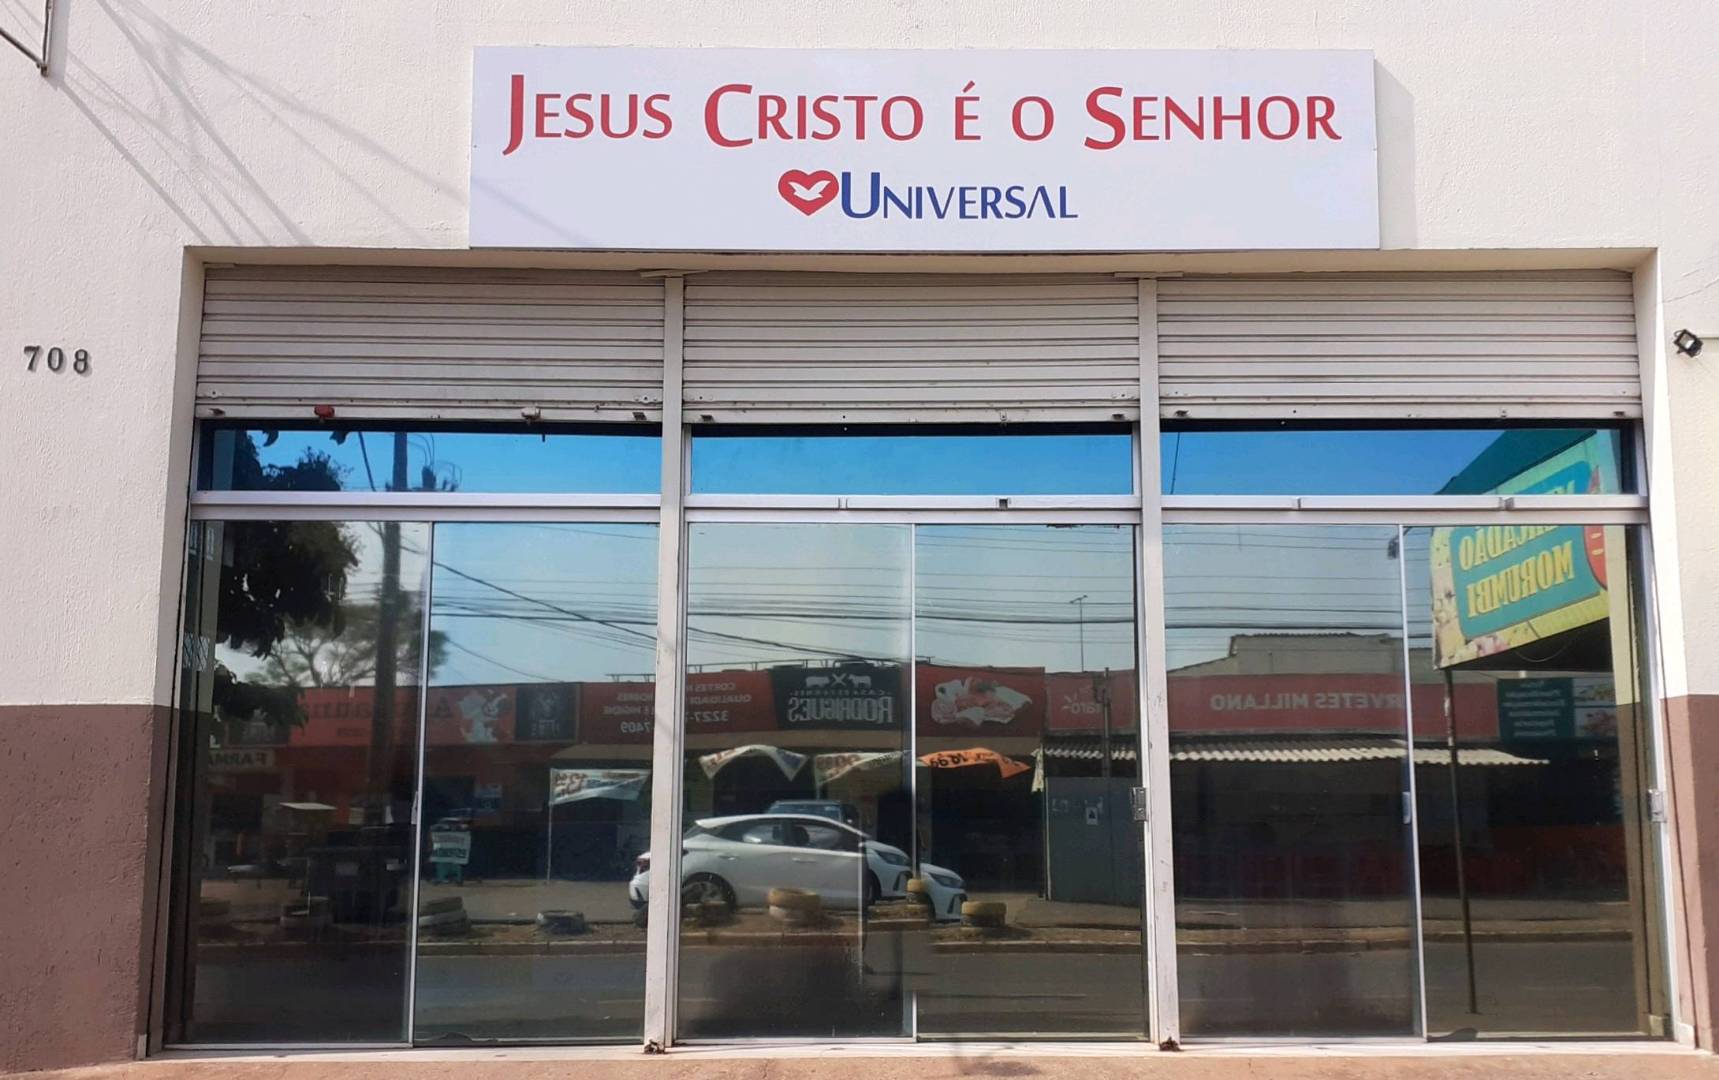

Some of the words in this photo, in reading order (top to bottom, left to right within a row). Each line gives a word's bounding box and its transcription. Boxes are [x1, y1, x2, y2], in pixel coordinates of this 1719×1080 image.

[504, 75, 673, 155] JESUS
[703, 83, 925, 149] CRISTO
[954, 81, 980, 141] É
[1011, 96, 1055, 141] O
[1084, 86, 1342, 151] SENHOR
[840, 171, 1078, 221] UNIVERSAL
[24, 345, 89, 375] 708
